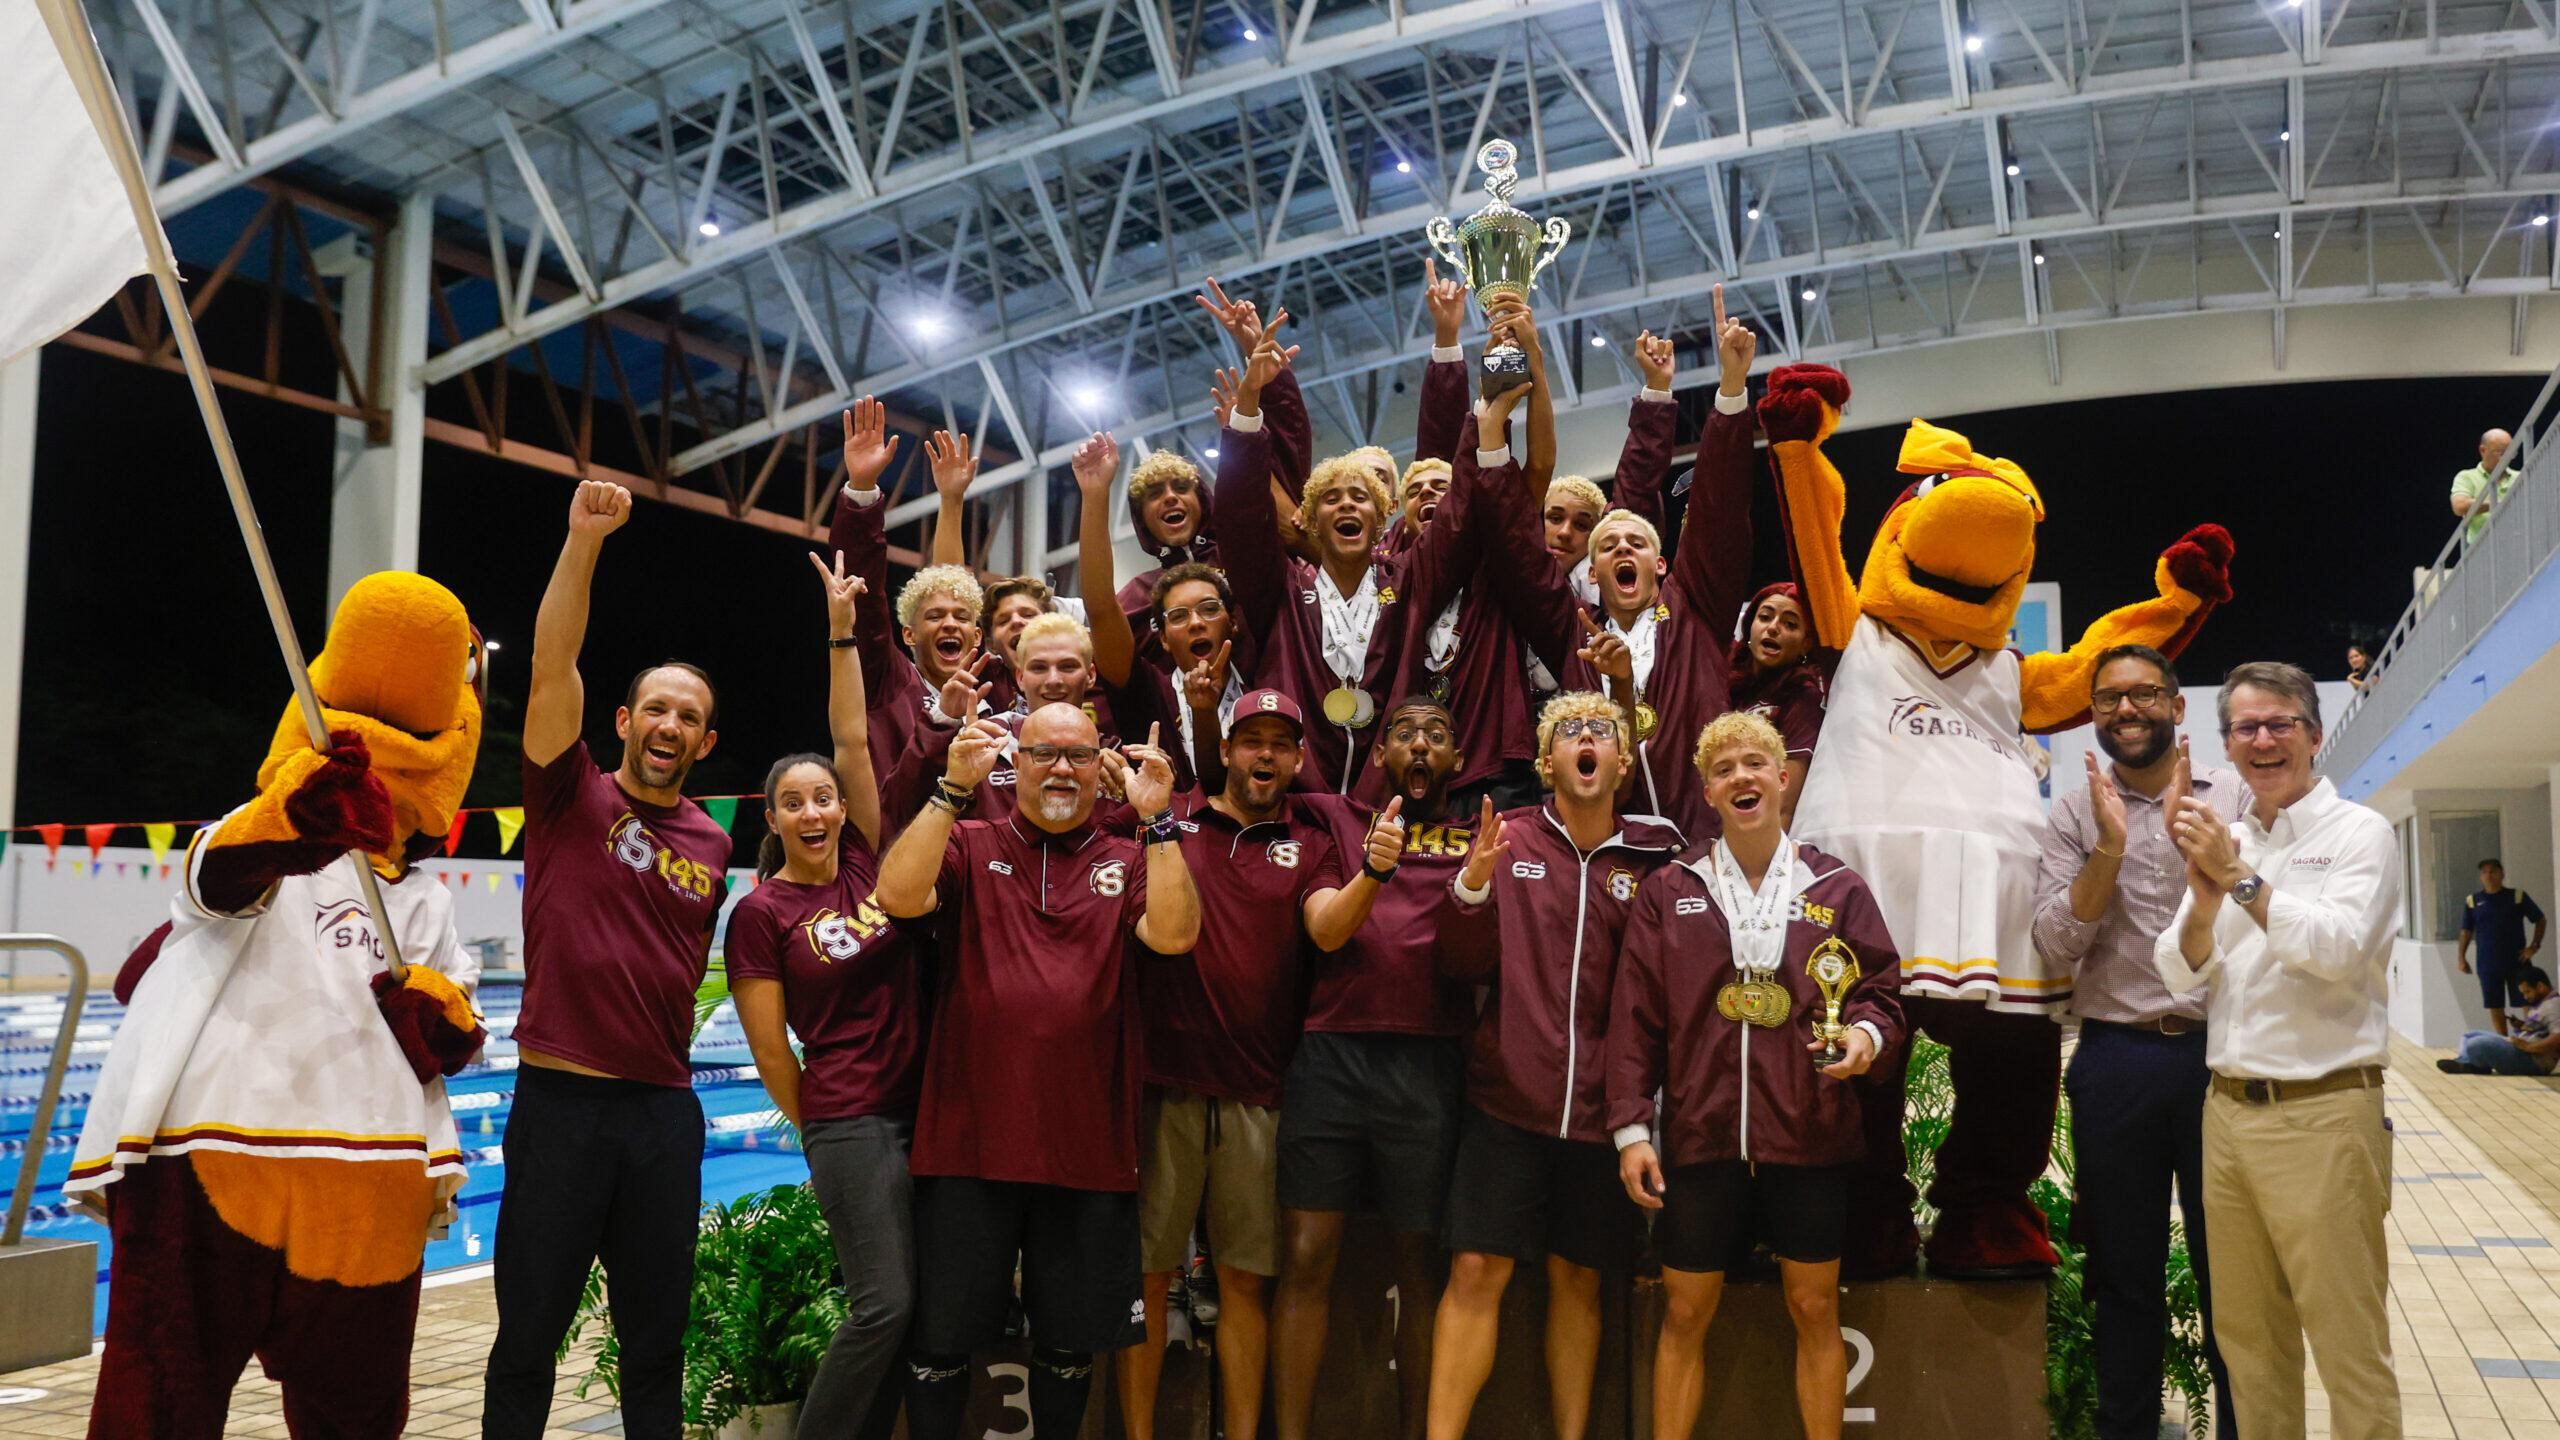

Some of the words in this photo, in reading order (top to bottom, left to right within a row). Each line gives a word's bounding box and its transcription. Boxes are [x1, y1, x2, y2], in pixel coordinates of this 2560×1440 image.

[2291, 856, 2335, 866] SAGRAD
[982, 1362, 1035, 1440] 3
[1840, 1326, 1876, 1422] 2
